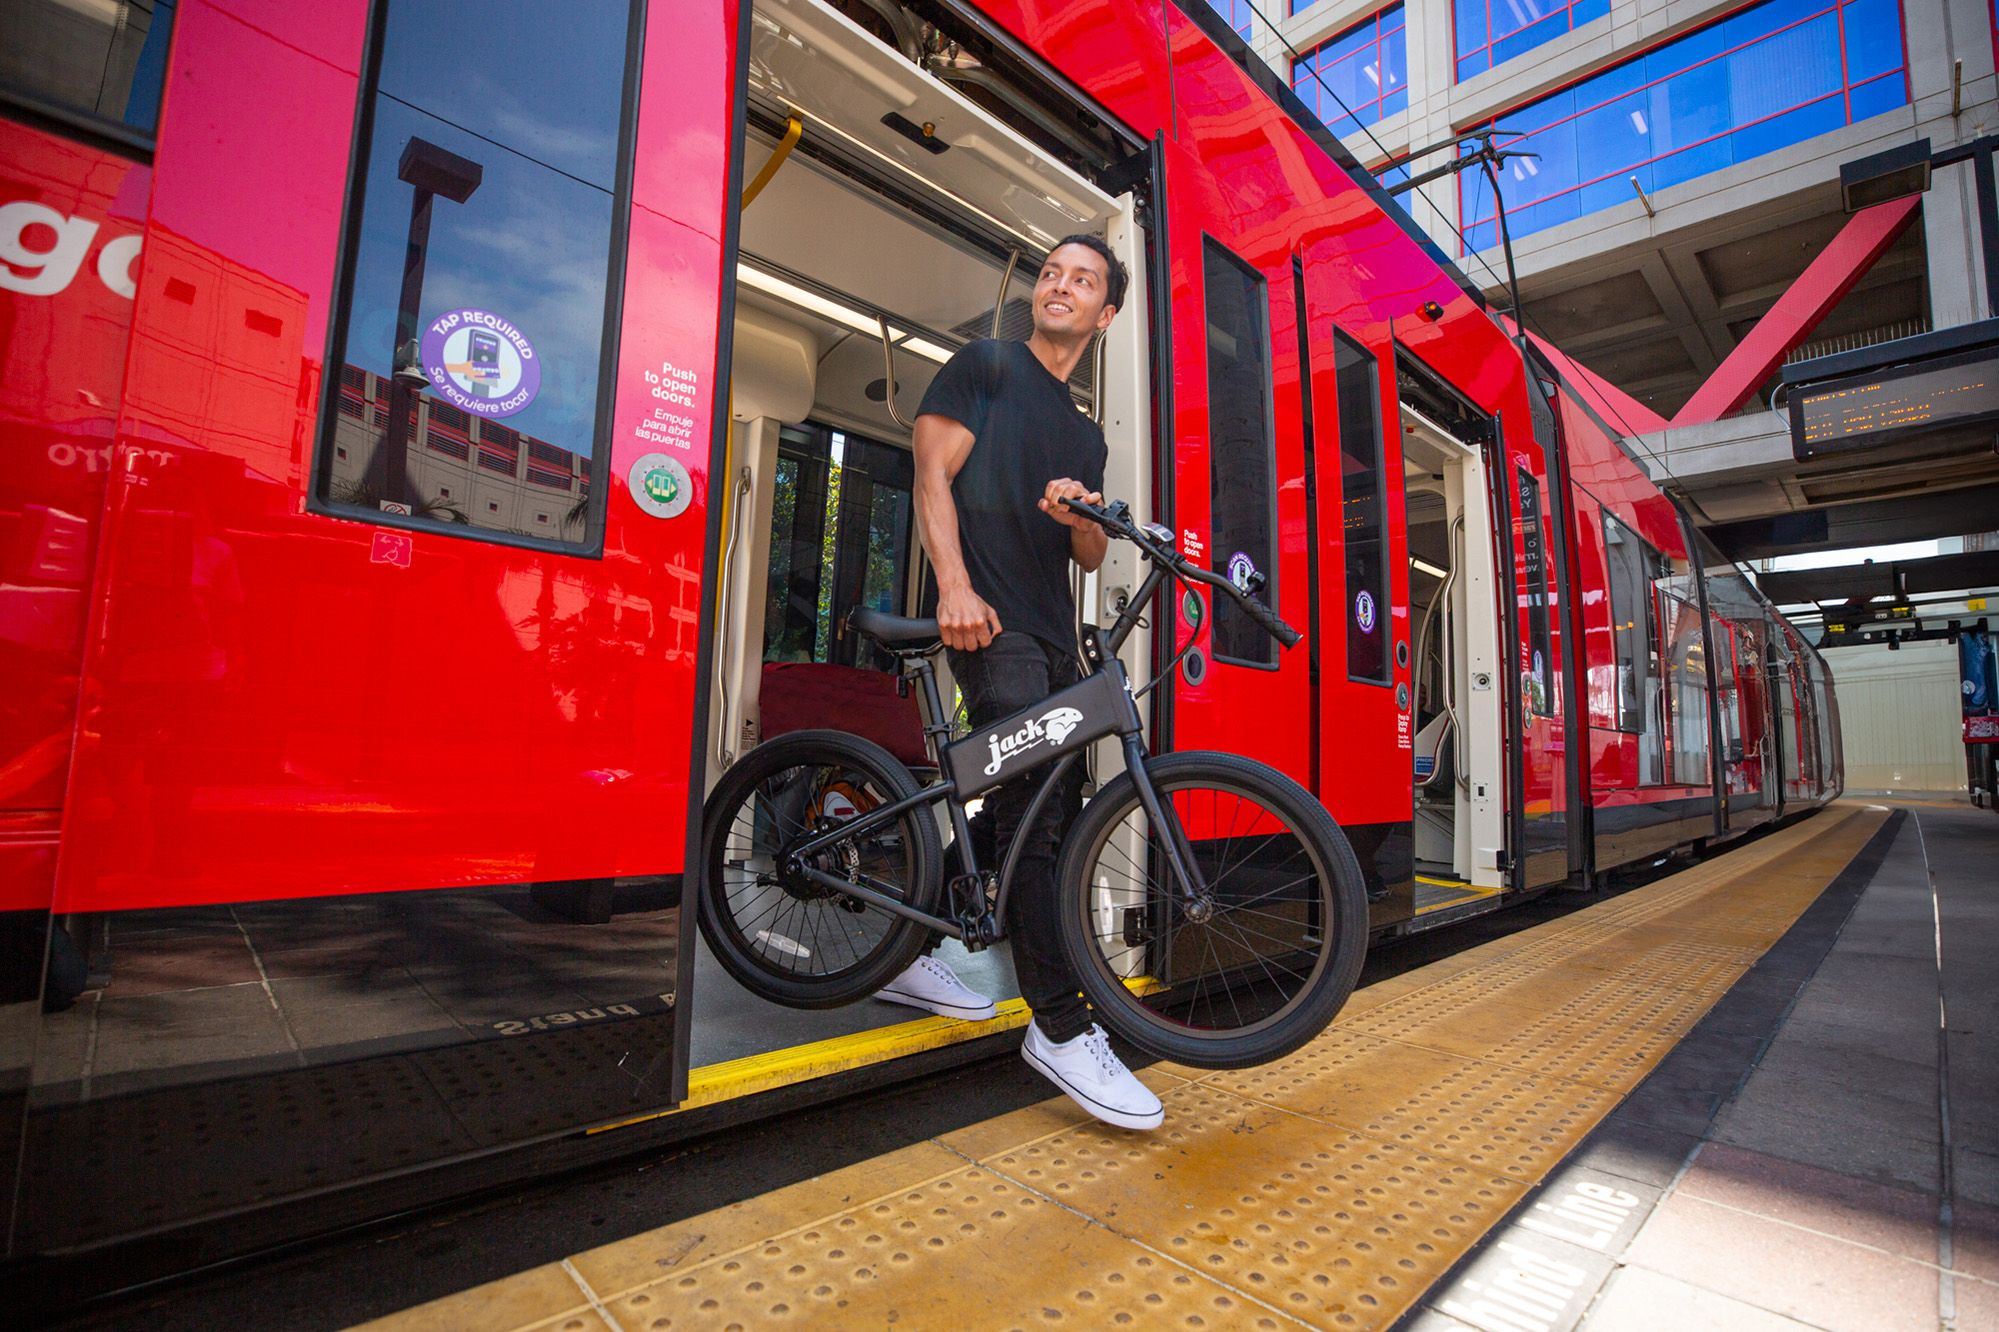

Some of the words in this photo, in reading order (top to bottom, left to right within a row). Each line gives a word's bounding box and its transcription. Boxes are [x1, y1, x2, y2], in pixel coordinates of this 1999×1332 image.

[432, 313, 459, 336] TAP
[462, 311, 533, 360] REQUIRED
[644, 369, 659, 384] to
[662, 377, 696, 396] open
[663, 361, 697, 384] Push
[430, 366, 445, 384] Se
[442, 384, 499, 413] requiere
[501, 387, 529, 412] tocar
[651, 386, 695, 408] doors.
[642, 418, 667, 432] para
[668, 425, 692, 438] abrir
[654, 407, 694, 428] Empuje
[635, 426, 651, 439] las
[651, 432, 691, 450] puertas
[1184, 529, 1198, 540] Push
[1190, 540, 1204, 550] open
[984, 719, 1046, 776] jack
[1520, 1181, 1640, 1250] Line
